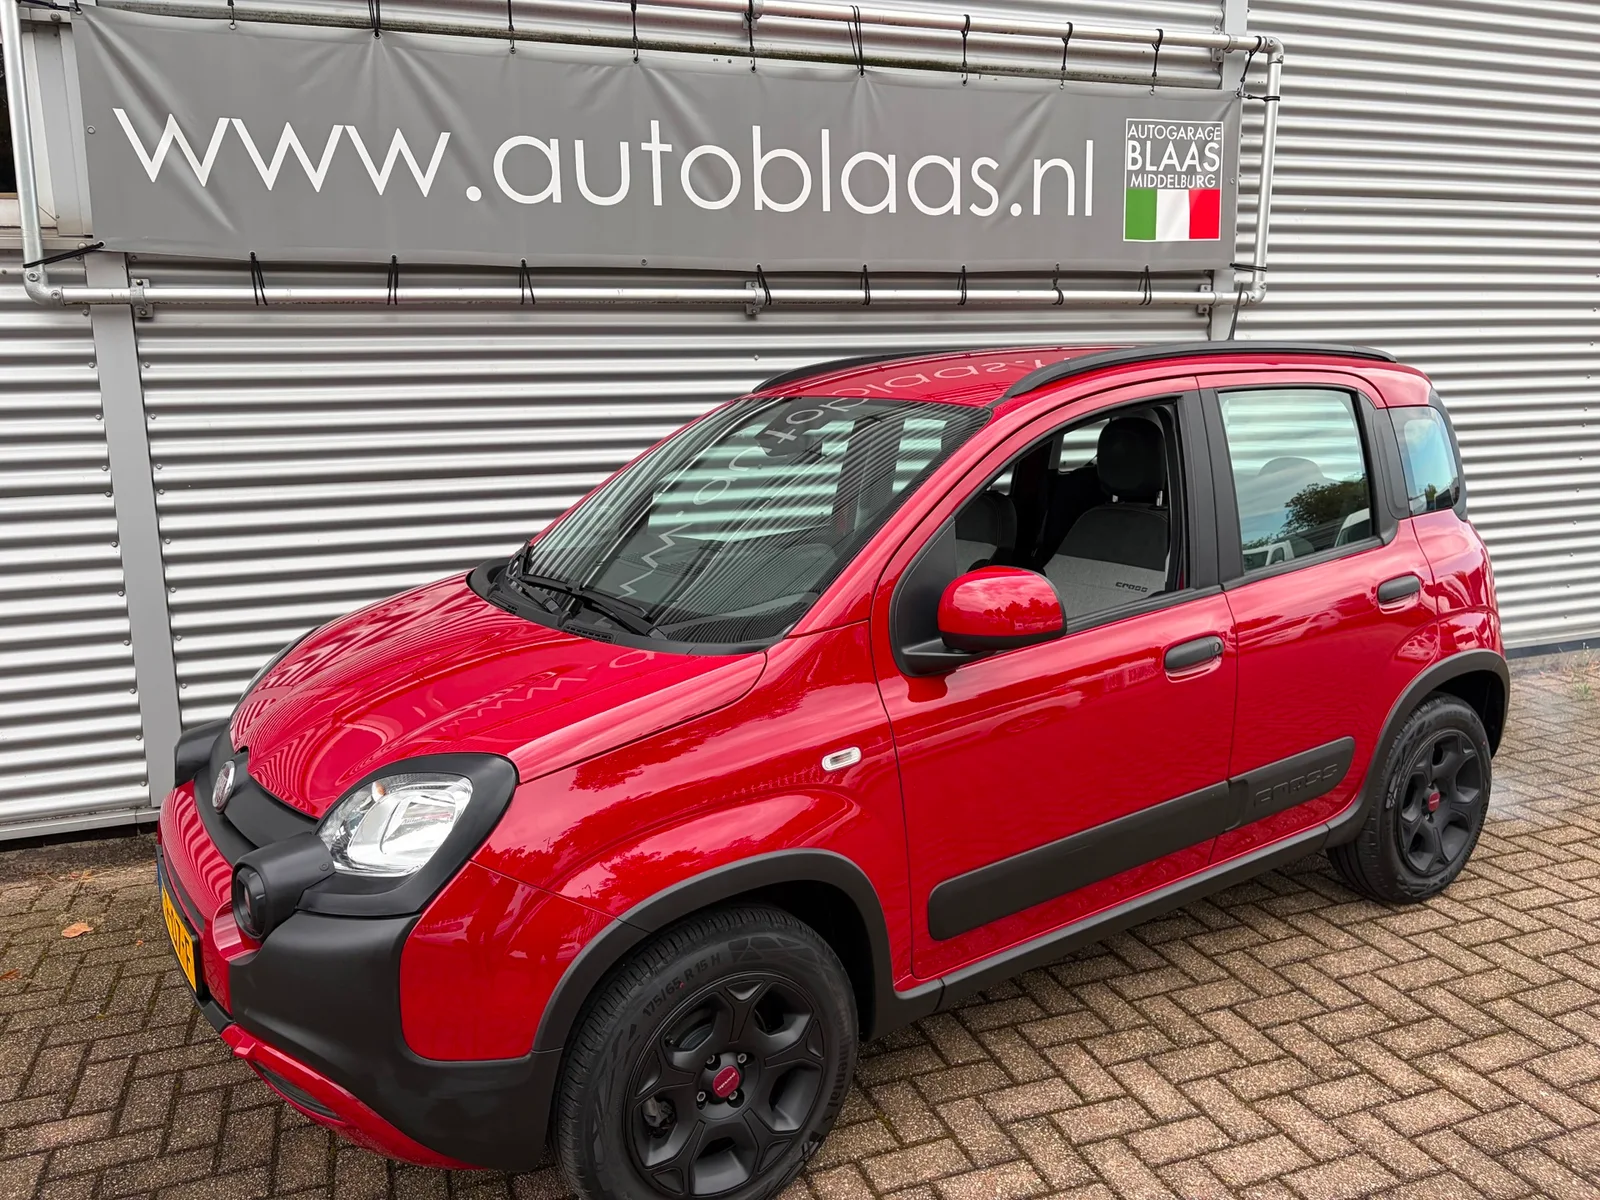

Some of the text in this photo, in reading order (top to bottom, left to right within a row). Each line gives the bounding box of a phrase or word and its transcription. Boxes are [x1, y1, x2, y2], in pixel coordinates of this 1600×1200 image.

[1127, 124, 1222, 141] AUTOGARAGE
[112, 107, 1095, 218] www.autoblaas.nl
[1127, 140, 1220, 172] BLAAS
[1130, 173, 1216, 188] MIDDELBURG
[643, 952, 721, 1017] 175/65 R 15 H
